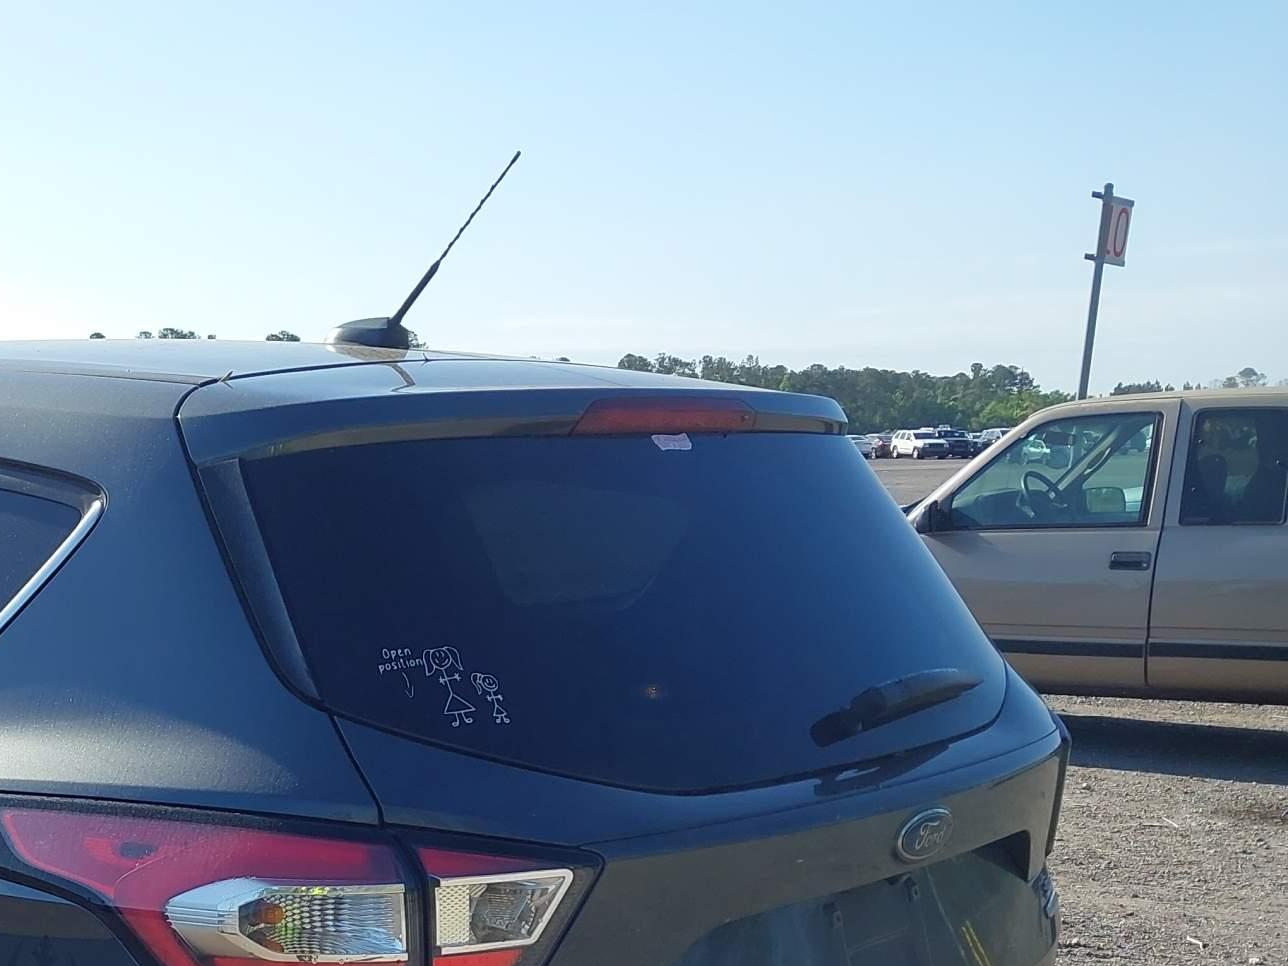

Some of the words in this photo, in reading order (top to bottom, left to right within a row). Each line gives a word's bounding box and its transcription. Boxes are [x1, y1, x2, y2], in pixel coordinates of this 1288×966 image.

[382, 648, 412, 661] Open
[378, 658, 424, 675] position
[915, 820, 947, 850] Ford
